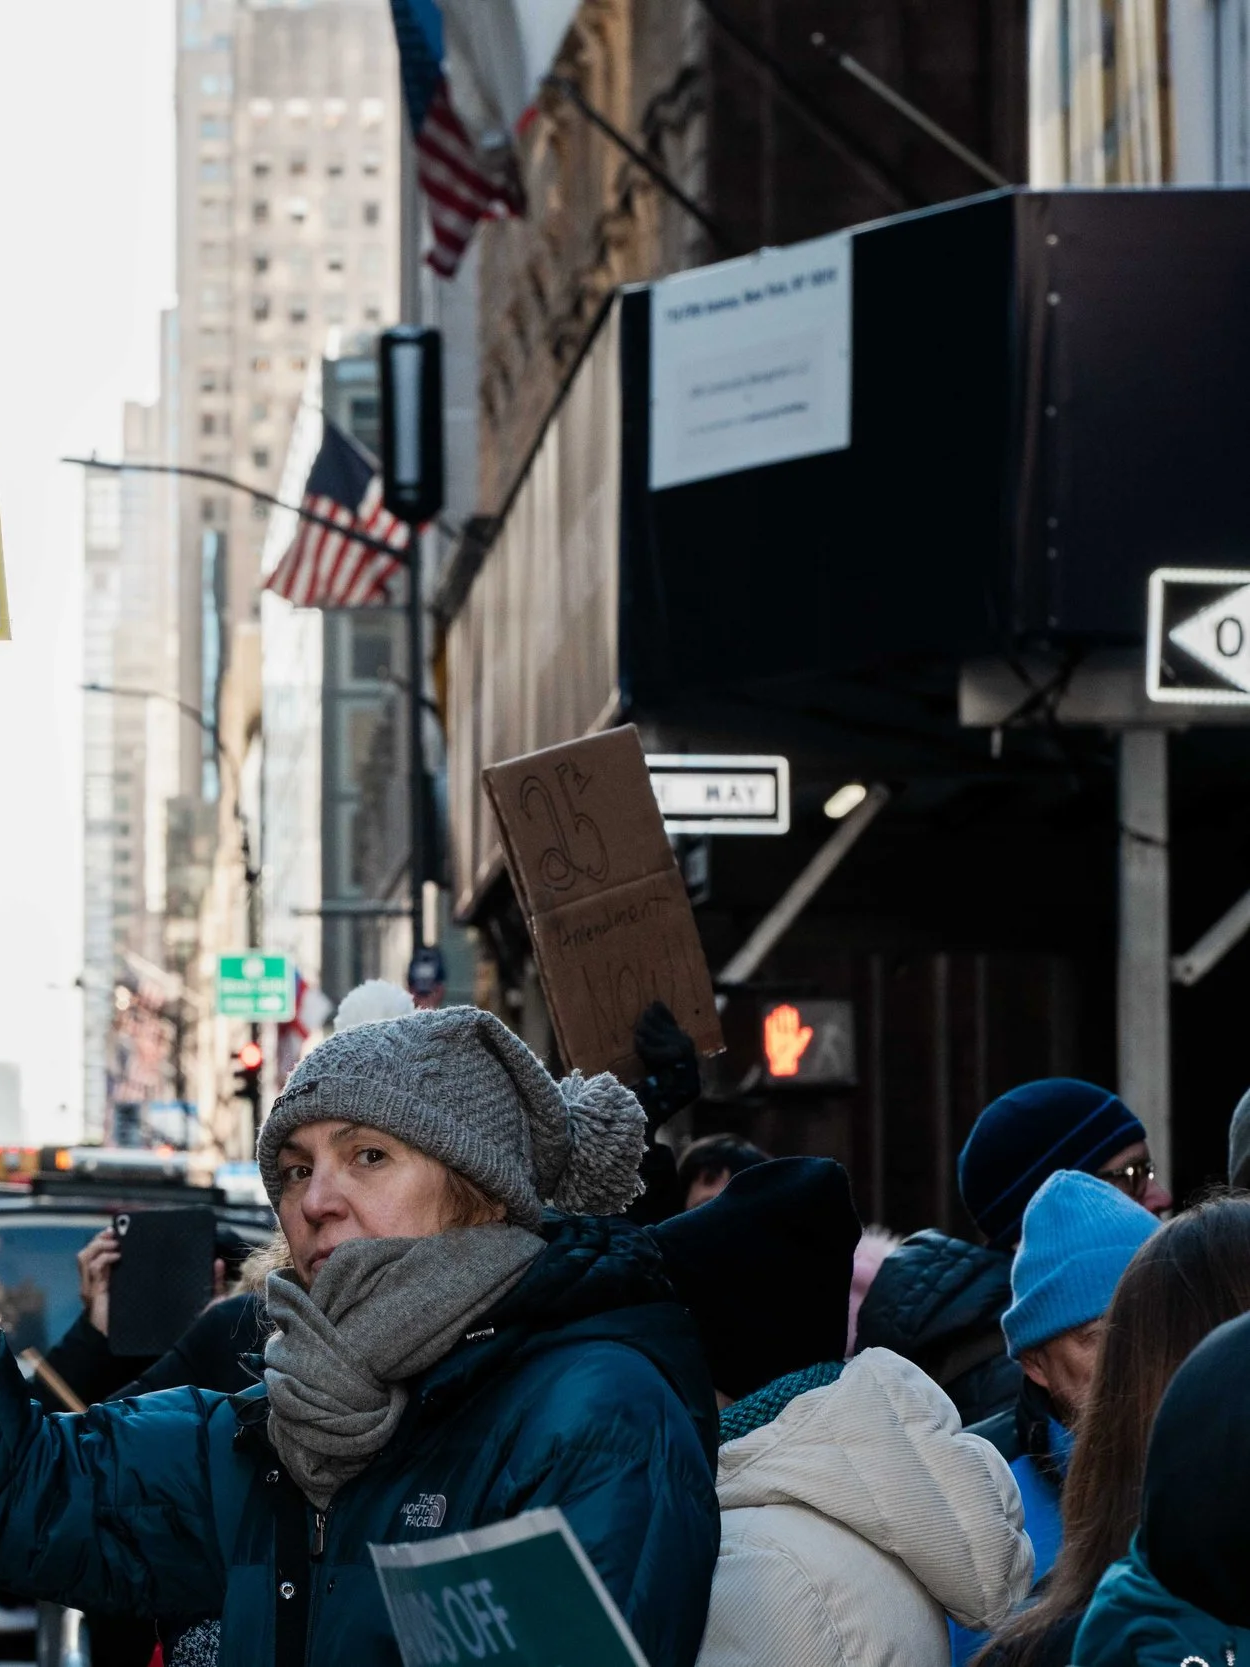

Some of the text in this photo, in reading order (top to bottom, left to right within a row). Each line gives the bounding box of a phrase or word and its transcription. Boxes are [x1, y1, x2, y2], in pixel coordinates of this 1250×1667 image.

[419, 1493, 436, 1505] THE
[400, 1503, 432, 1516] NORTH
[405, 1515, 429, 1528] FACE
[440, 1578, 517, 1660] OFF
